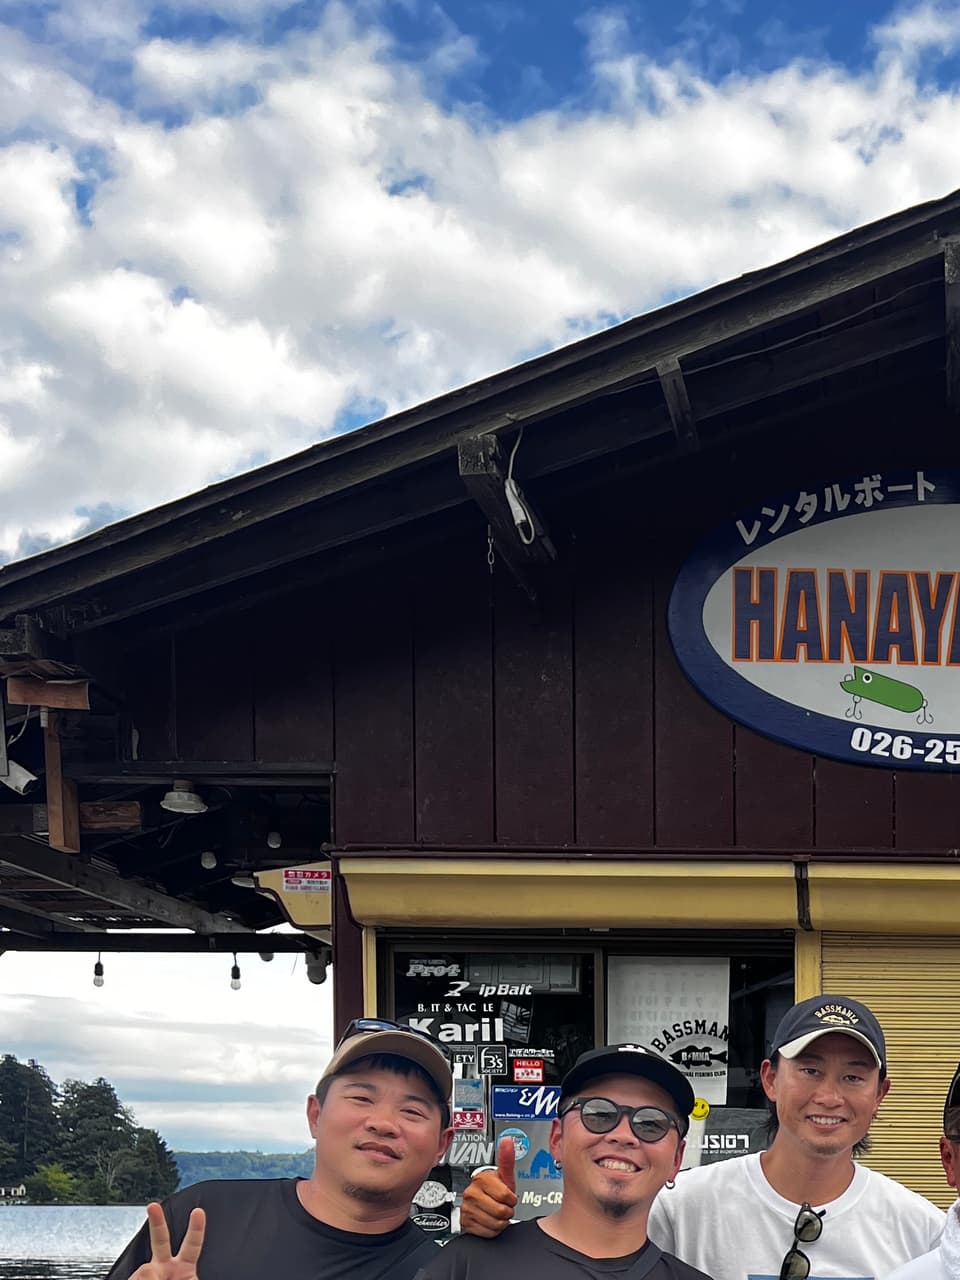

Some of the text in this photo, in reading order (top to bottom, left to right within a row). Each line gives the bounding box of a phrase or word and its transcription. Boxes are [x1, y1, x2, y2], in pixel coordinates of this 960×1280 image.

[735, 471, 936, 545] レンタルボート
[444, 1003, 452, 1012] &
[814, 1005, 859, 1024] BASSMANIA
